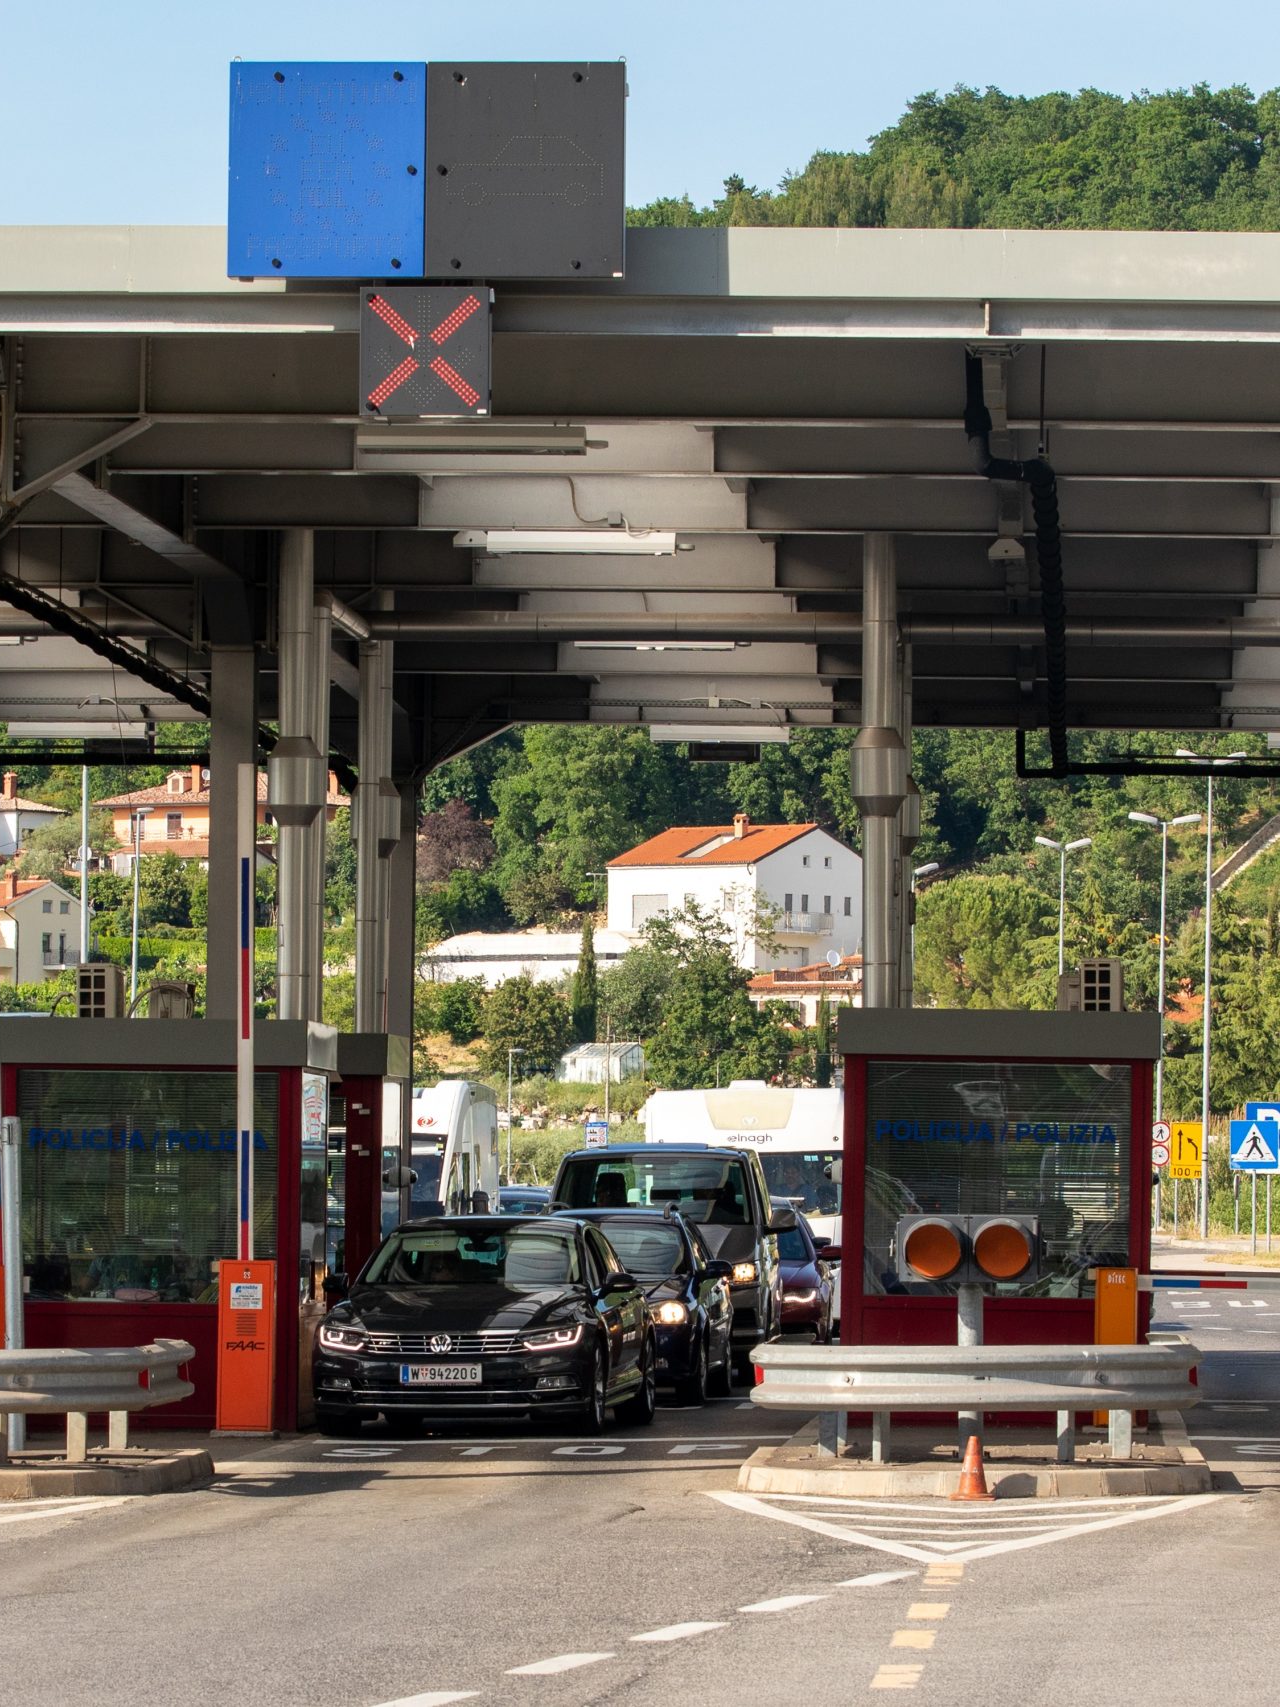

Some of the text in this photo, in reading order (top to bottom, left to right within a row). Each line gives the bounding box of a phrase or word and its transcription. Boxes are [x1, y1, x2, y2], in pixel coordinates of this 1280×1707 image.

[875, 1119, 994, 1142] POLICIJA
[1016, 1122, 1117, 1144] POLIZIA
[28, 1127, 146, 1150] POLICIJA
[167, 1129, 268, 1151] POLIZA
[727, 1133, 773, 1145] elnagh
[1173, 1167, 1191, 1177] 100
[226, 1341, 265, 1351] FAAC
[411, 1367, 420, 1380] W
[429, 1367, 468, 1380] 94220
[321, 1444, 748, 1457] STOP
